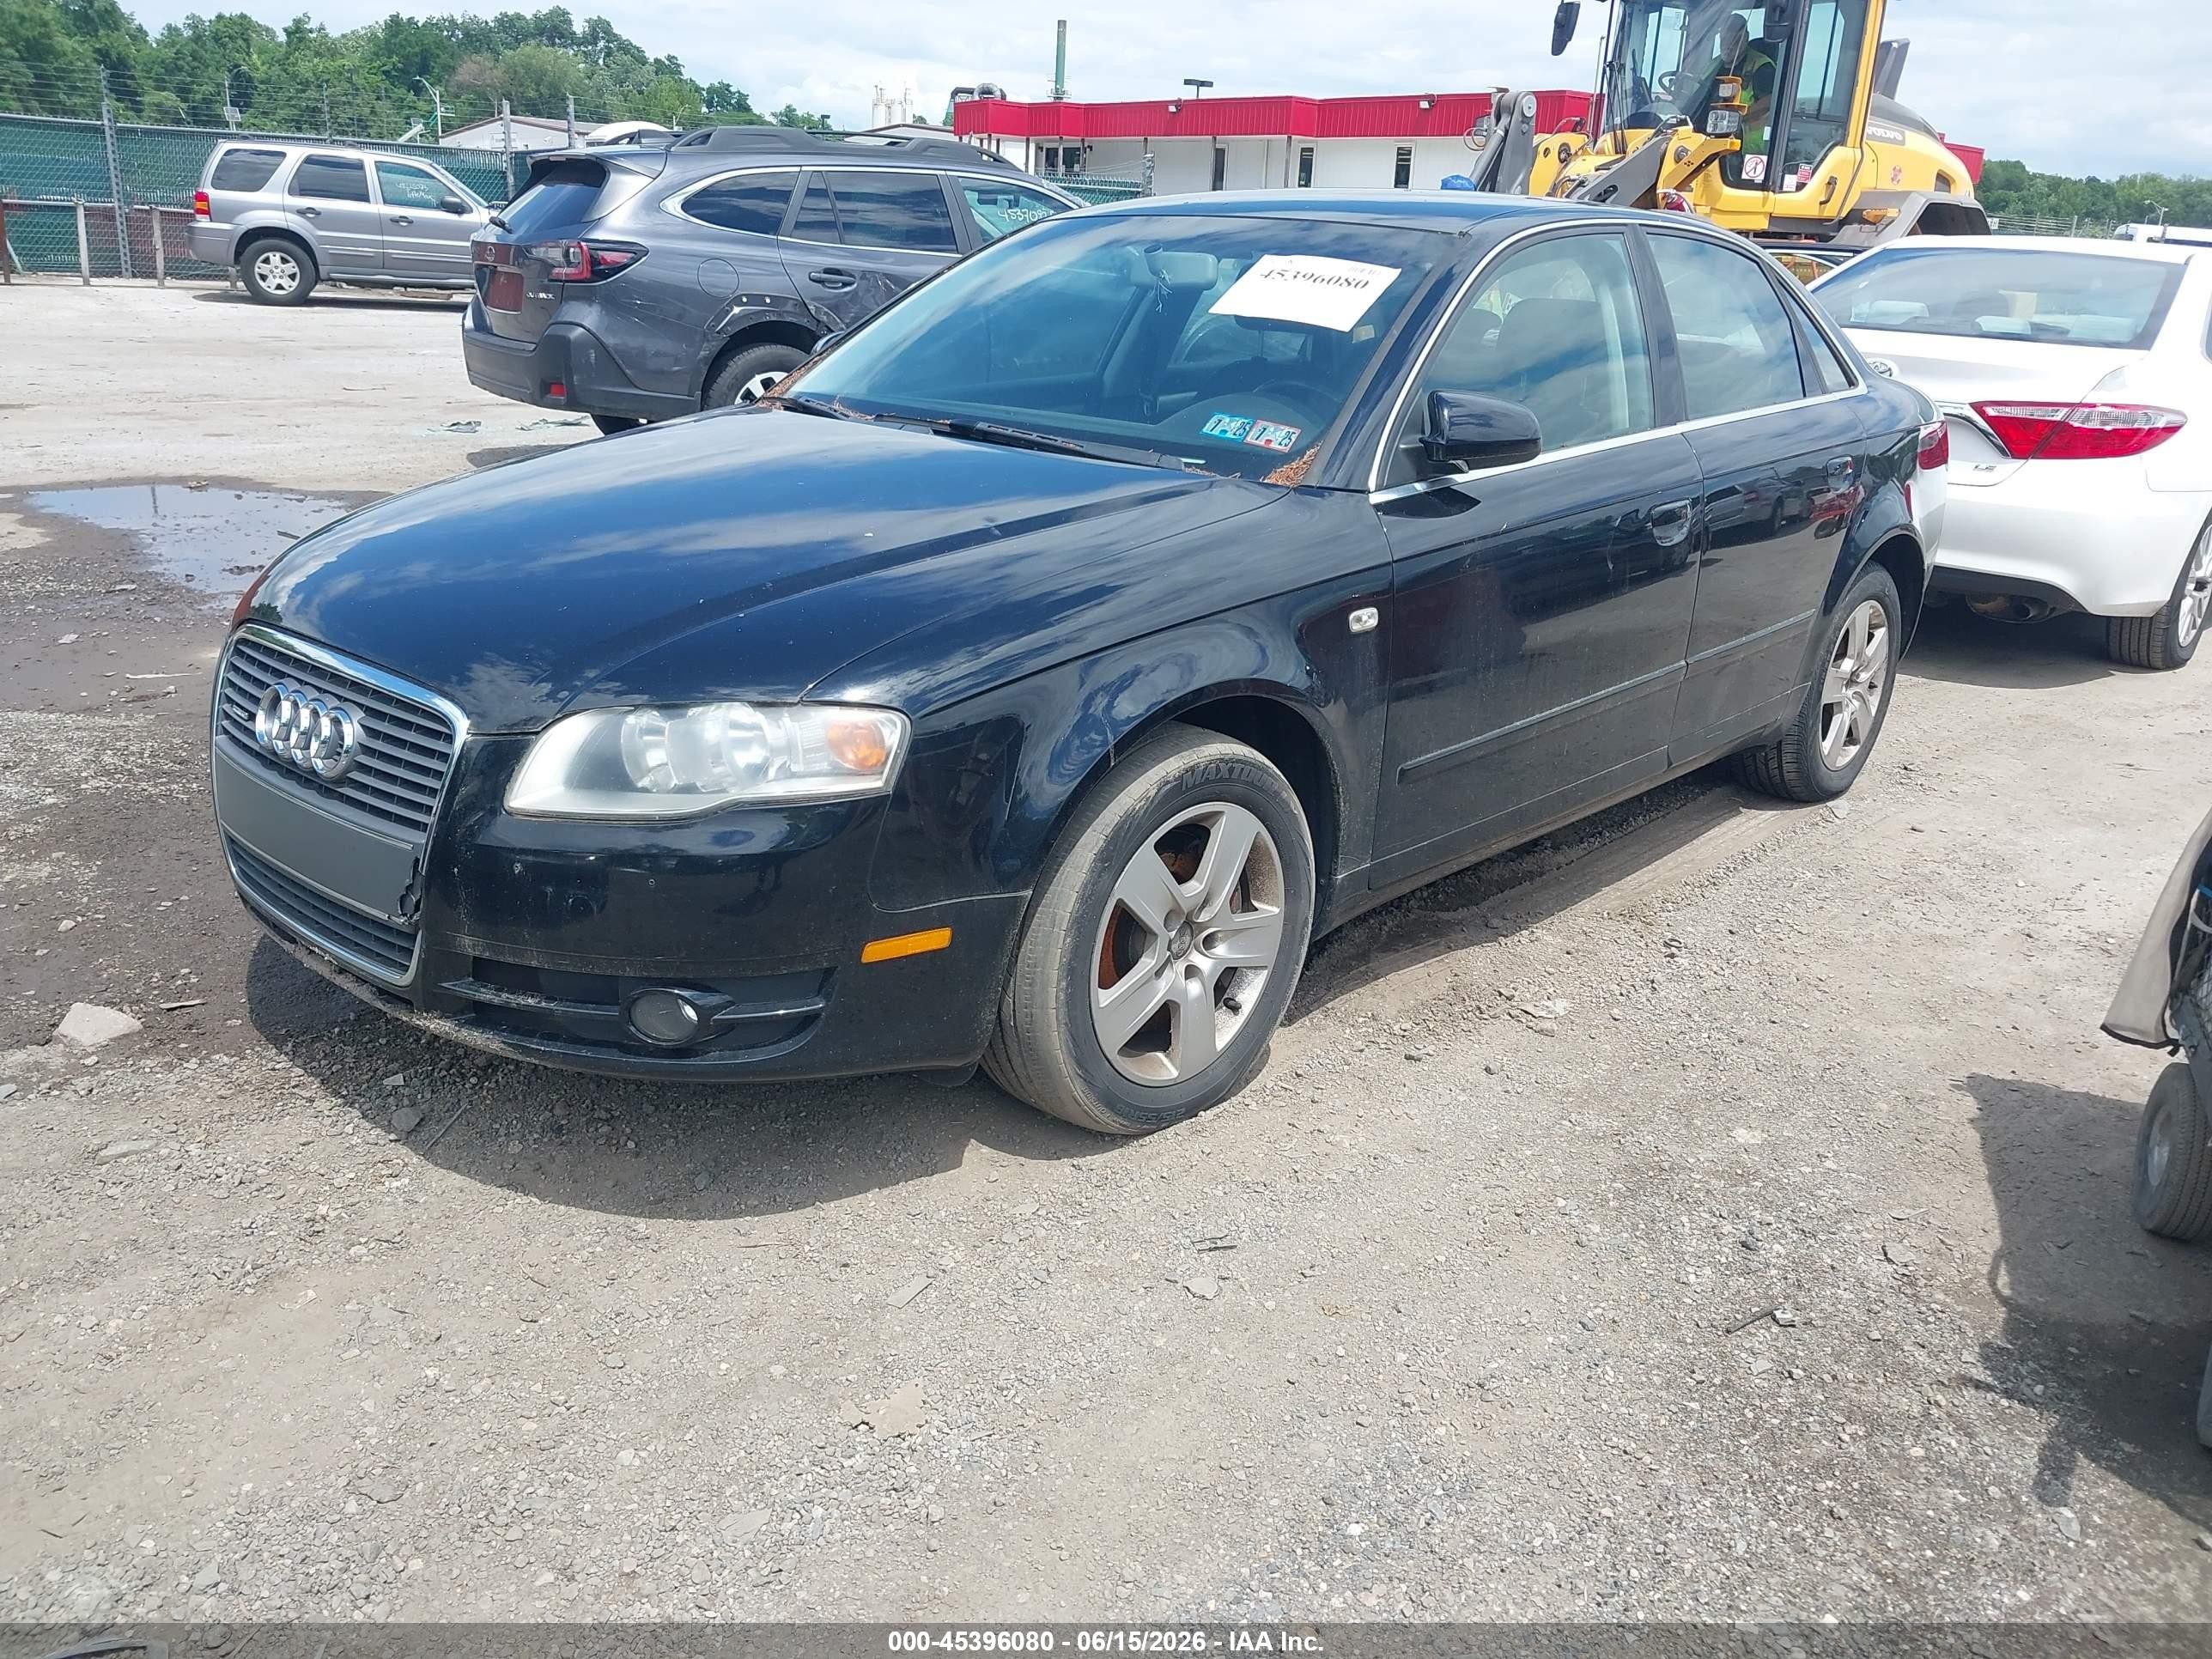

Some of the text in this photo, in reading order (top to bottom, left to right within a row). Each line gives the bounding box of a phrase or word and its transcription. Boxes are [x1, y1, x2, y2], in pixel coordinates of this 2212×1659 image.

[1260, 269, 1370, 290] 45396080
[1233, 421, 1251, 437] 25
[1279, 430, 1296, 447] 25
[1182, 763, 1279, 796] MAXTOUR
